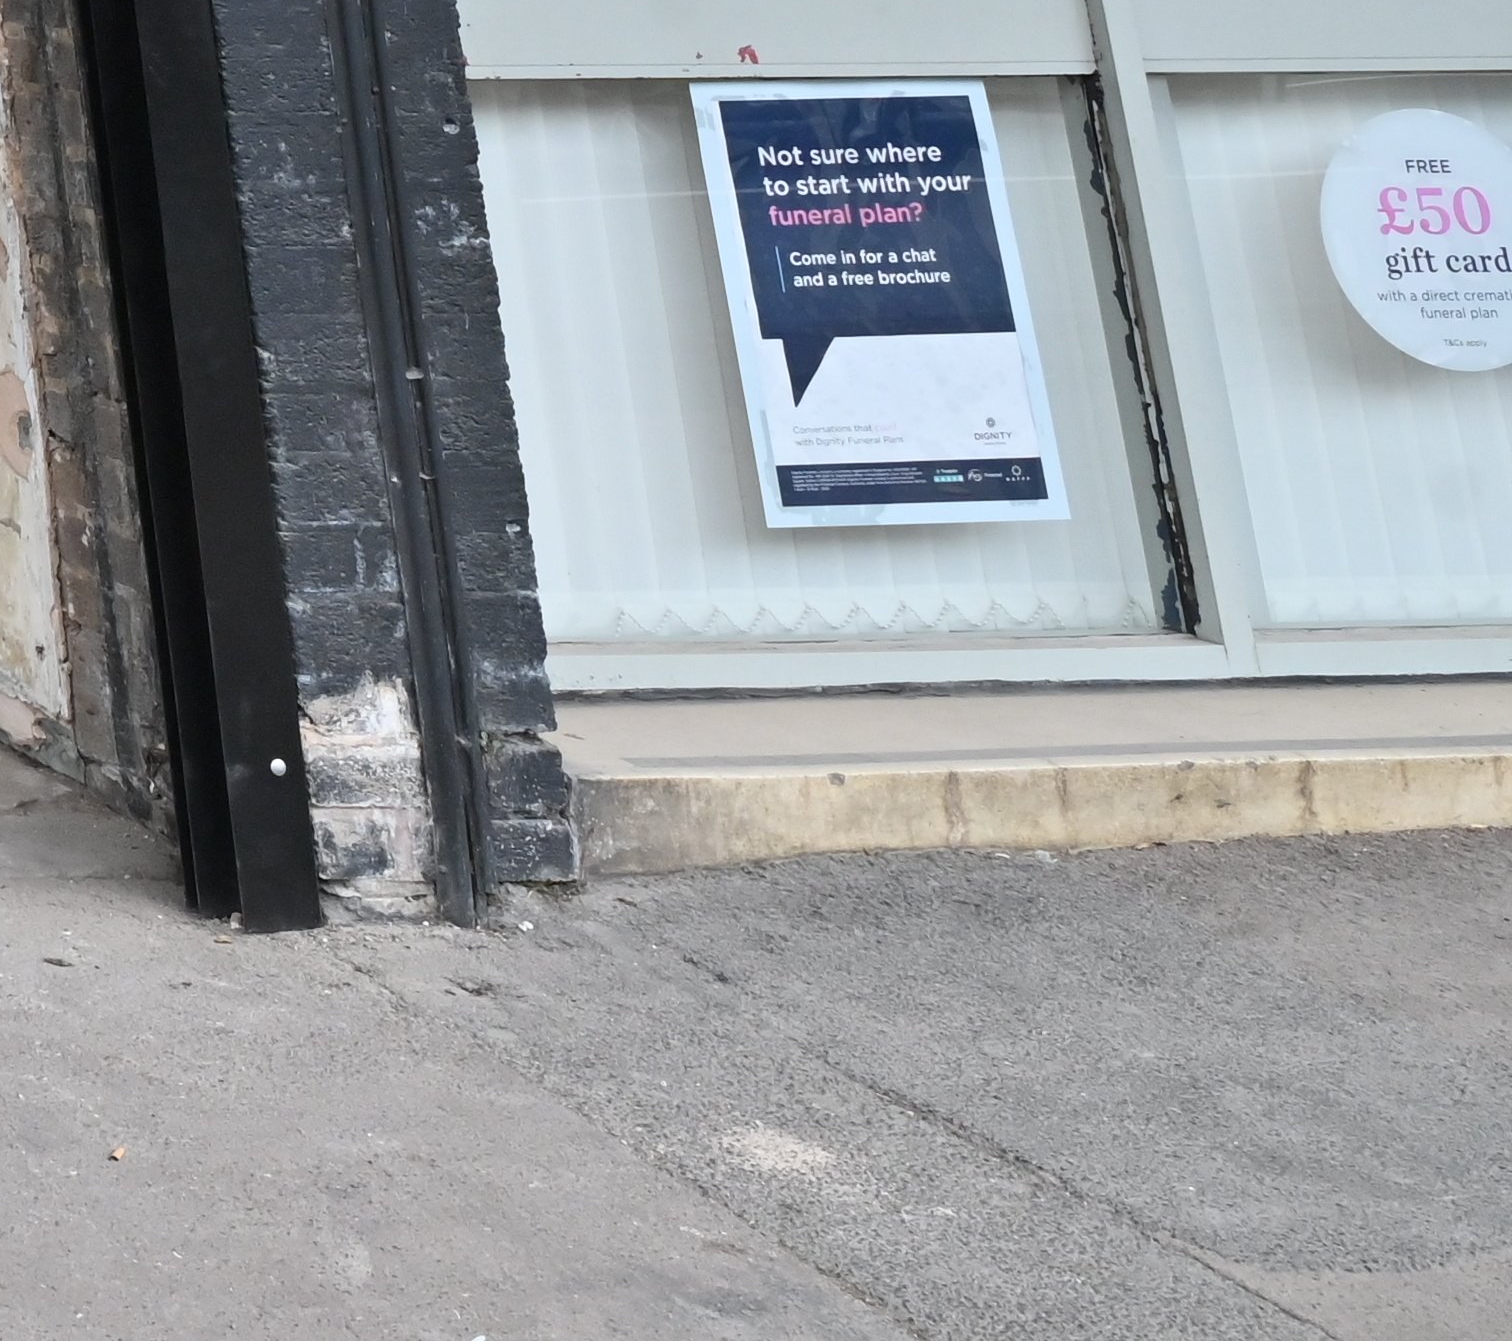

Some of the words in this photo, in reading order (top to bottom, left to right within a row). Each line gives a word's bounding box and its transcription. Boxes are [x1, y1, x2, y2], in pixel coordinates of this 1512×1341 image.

[757, 146, 804, 166] Not
[811, 147, 860, 164] sure
[866, 142, 942, 163] where
[1405, 159, 1452, 173] FREE
[763, 176, 789, 196] to
[797, 174, 851, 195] start
[857, 172, 910, 193] with
[917, 174, 971, 196] your
[769, 203, 852, 226] funeral
[859, 202, 923, 227] plan?
[1377, 186, 1491, 235] £50
[790, 251, 837, 266] Come
[841, 249, 856, 264] in
[860, 249, 883, 264] for
[888, 252, 898, 263] a
[902, 248, 936, 263] chat
[1385, 247, 1438, 280] gift
[1445, 246, 1512, 273] card
[793, 272, 824, 287] and
[828, 276, 838, 286] a
[841, 270, 873, 285] free
[878, 269, 951, 285] brochure
[1377, 289, 1406, 302] with
[1410, 292, 1418, 302] a
[1421, 289, 1460, 302] direct
[1420, 307, 1465, 319] funeral
[1470, 307, 1498, 320] plan
[974, 431, 1012, 441] DIGNITY
